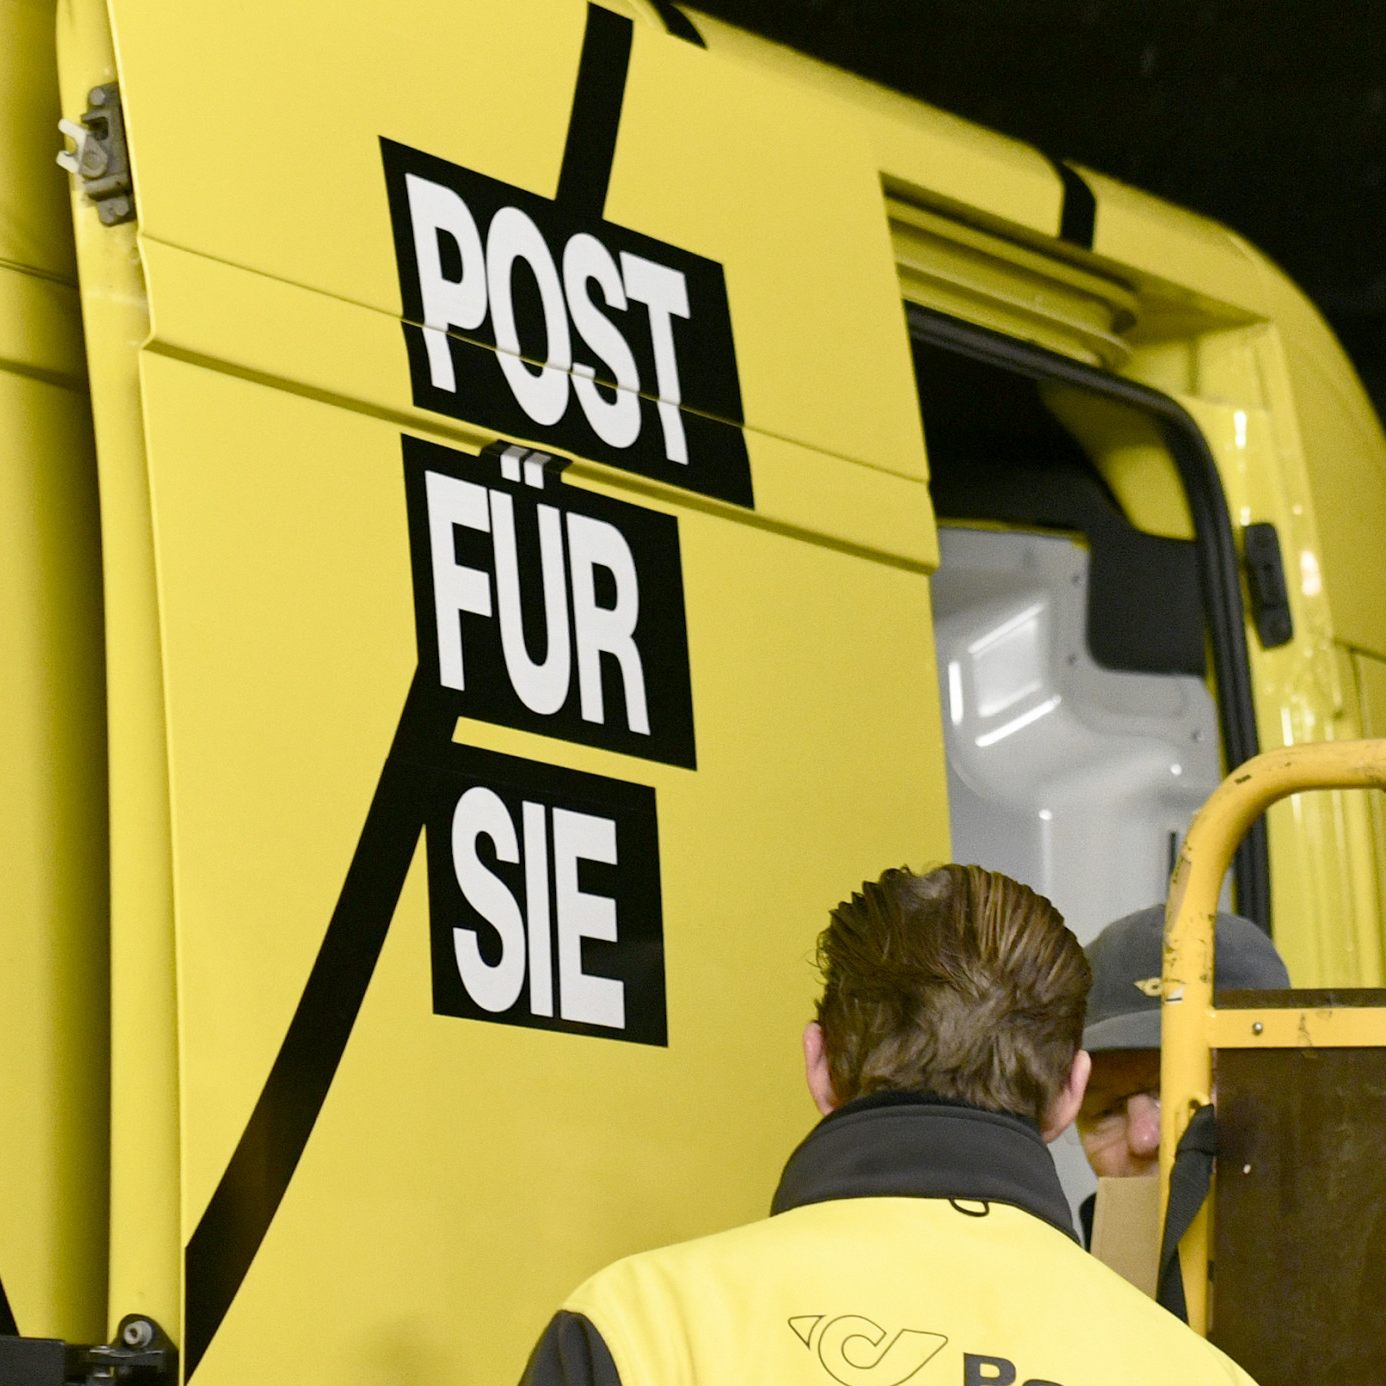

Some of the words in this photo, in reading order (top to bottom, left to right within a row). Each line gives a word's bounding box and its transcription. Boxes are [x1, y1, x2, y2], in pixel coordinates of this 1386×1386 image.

[405, 172, 690, 465] POST
[425, 446, 651, 736] FÜR
[451, 786, 626, 1030] SIE
